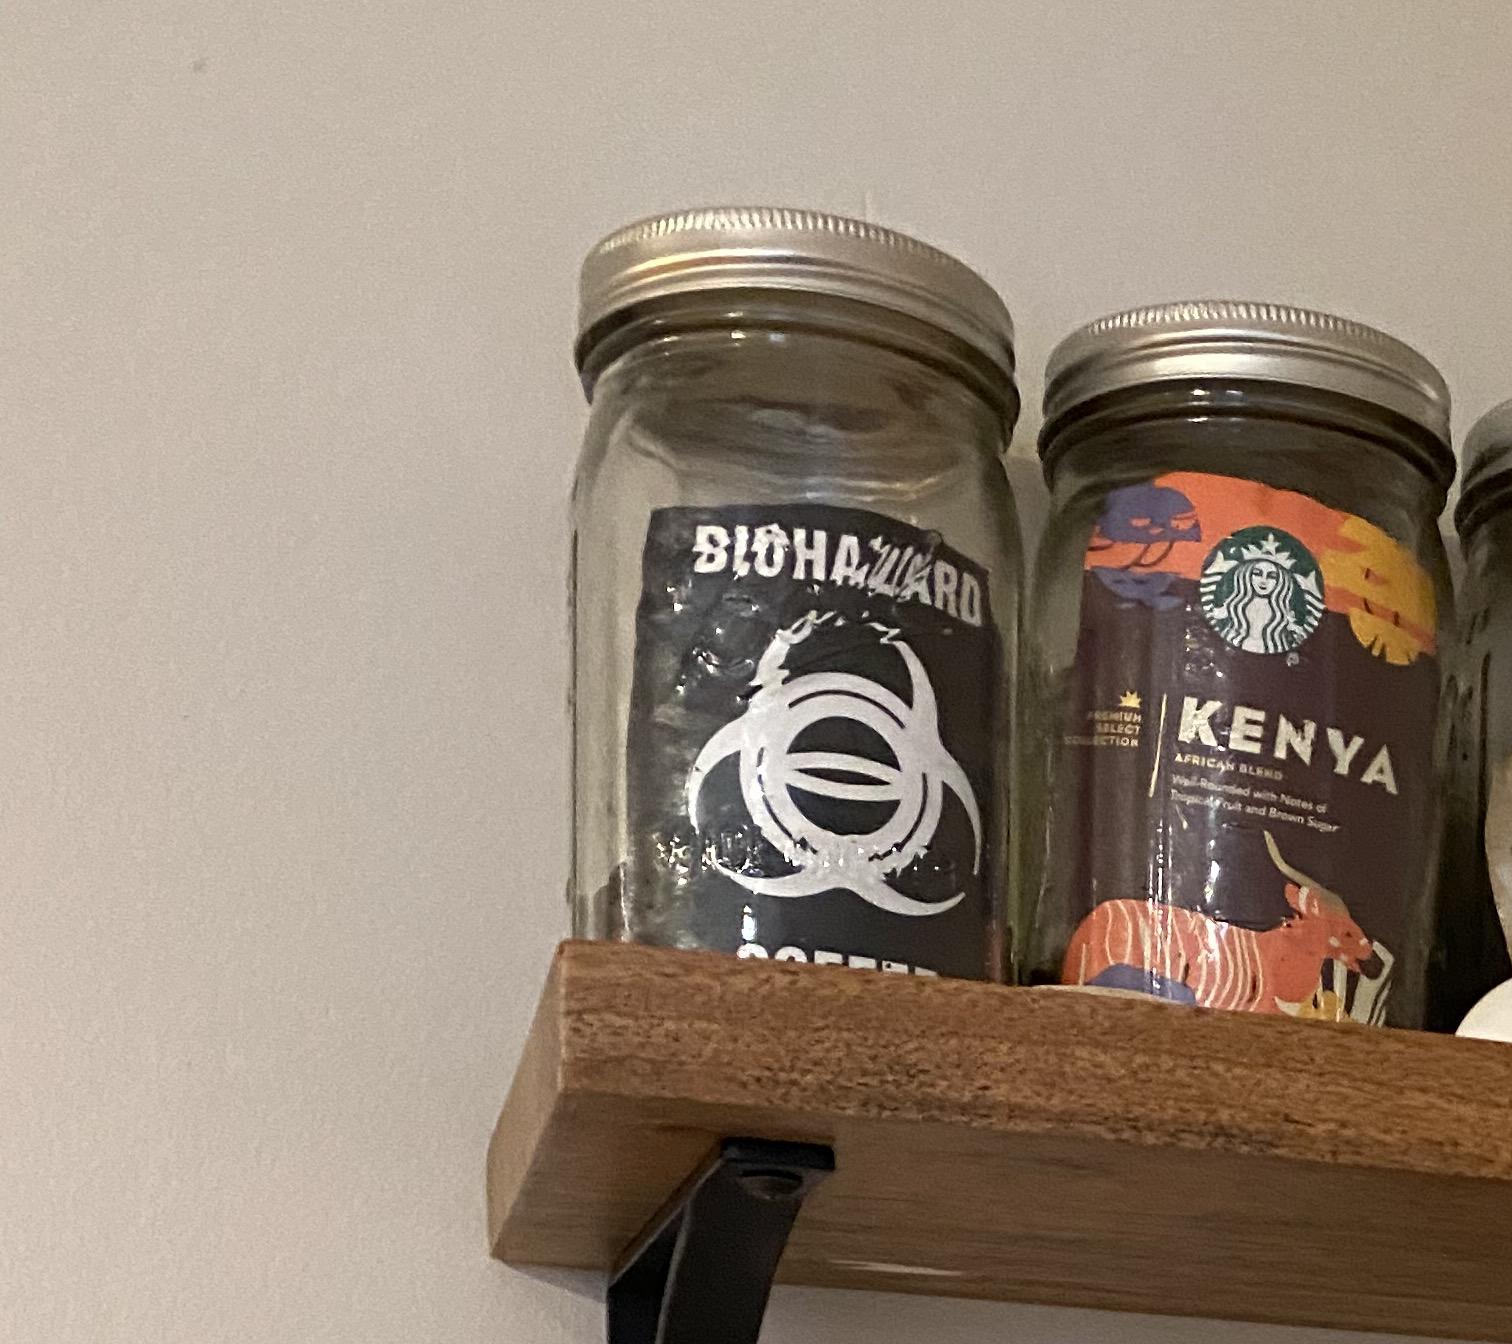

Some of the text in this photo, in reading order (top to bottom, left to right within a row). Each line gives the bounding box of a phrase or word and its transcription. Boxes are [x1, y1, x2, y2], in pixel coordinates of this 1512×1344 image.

[1178, 696, 1399, 796] KENYA
[1174, 752, 1283, 781] AFRICAN BLEND
[1269, 807, 1304, 824] Brown
